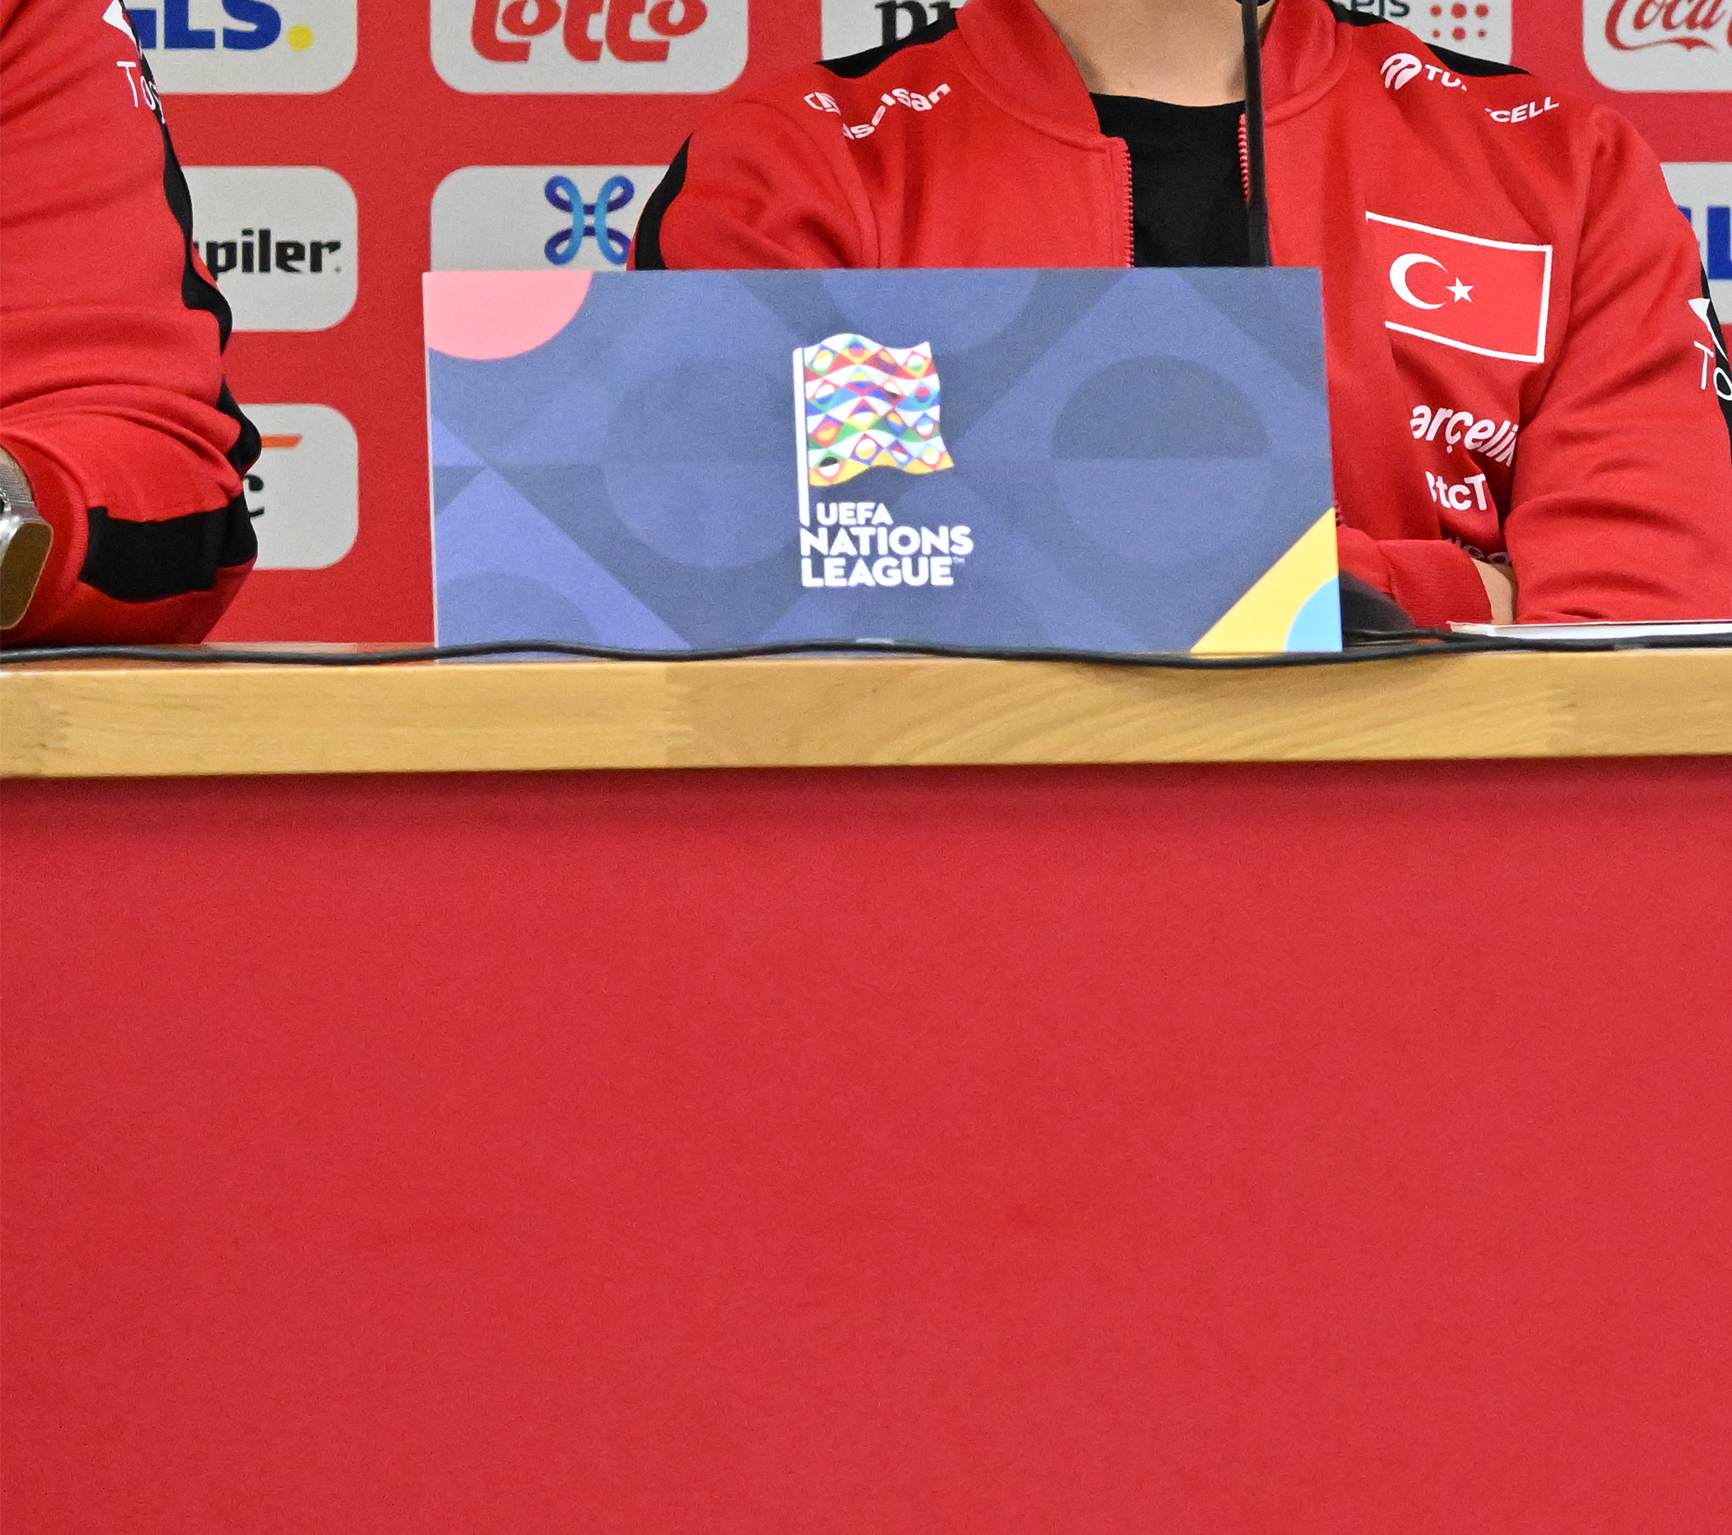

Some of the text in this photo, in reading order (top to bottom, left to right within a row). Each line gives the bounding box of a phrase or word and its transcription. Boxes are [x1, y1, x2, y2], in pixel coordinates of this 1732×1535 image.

[1424, 64, 1560, 124] TUCELL
[195, 227, 343, 275] piler
[816, 501, 895, 526] UEFA
[800, 525, 975, 556] NATIONS
[801, 556, 955, 588] LEAGUE
